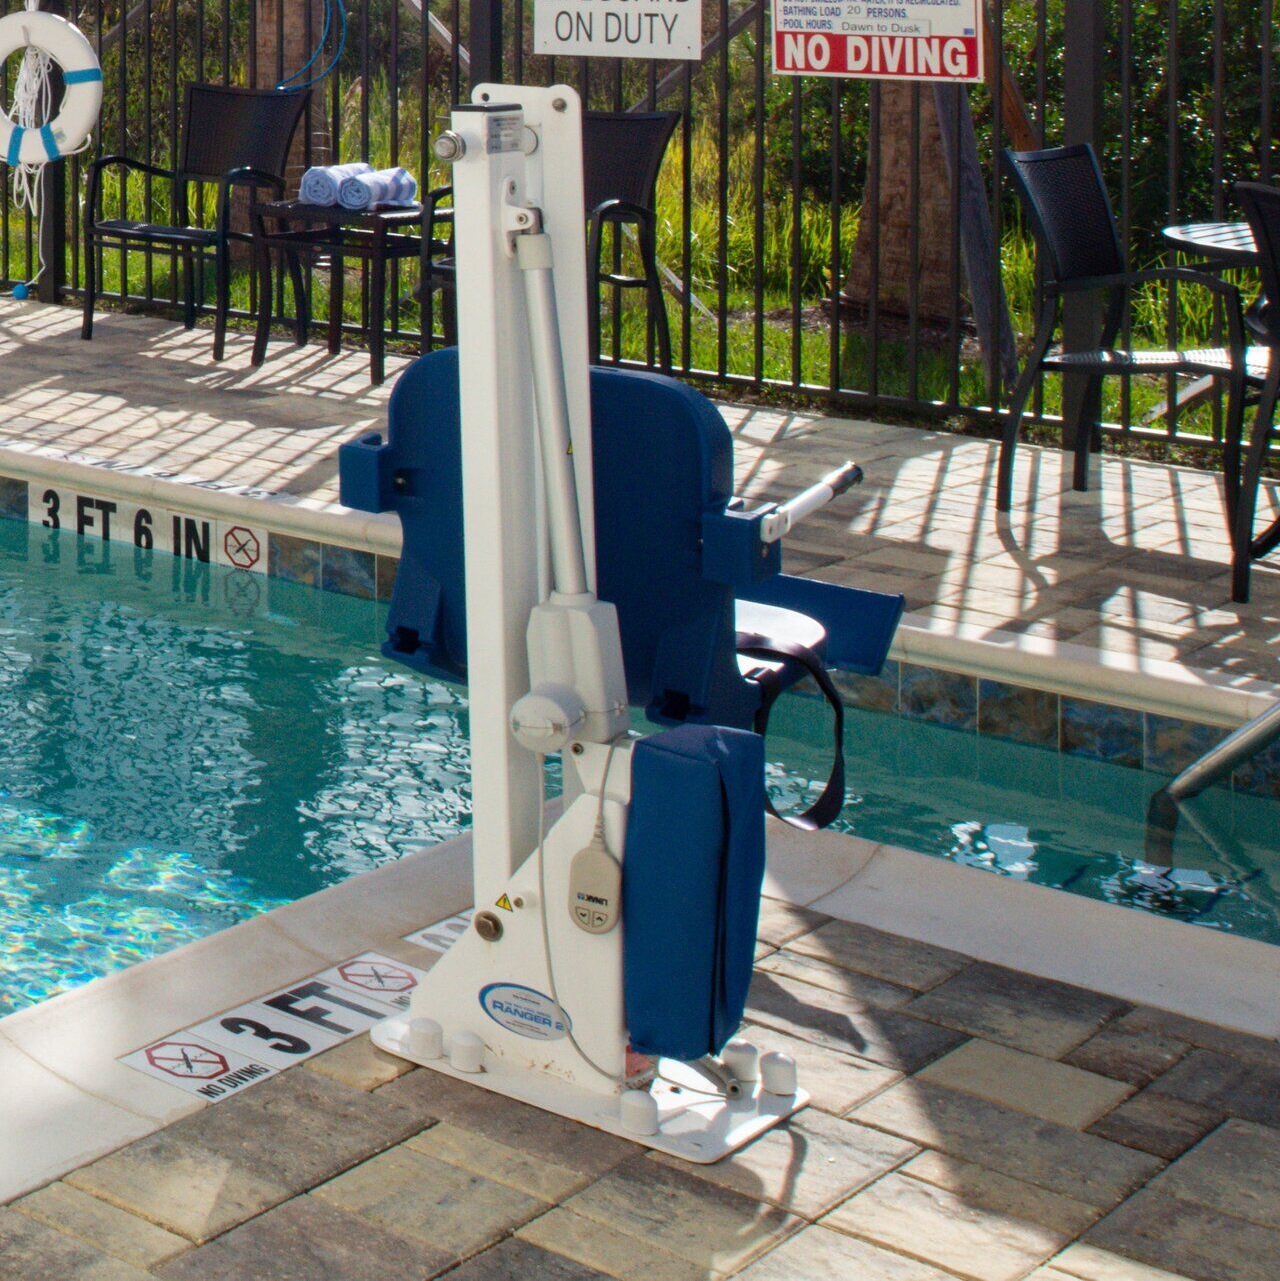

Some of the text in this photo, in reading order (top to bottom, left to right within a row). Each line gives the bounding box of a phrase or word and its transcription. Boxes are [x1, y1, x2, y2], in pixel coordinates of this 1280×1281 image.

[555, 11, 678, 44] ON DUTY
[783, 6, 817, 16] BATHING
[820, 7, 841, 17] LOAD
[847, 5, 861, 15] 20
[783, 18, 803, 29] POOL
[841, 21, 873, 31] Dawn
[877, 23, 887, 31] to
[891, 23, 920, 33] Dusk
[784, 33, 968, 76] NO DIVING
[42, 489, 210, 563] 3 FT 6 IN
[218, 981, 388, 1054] 3 FT
[492, 999, 553, 1028] RANGER
[197, 1063, 271, 1099] NO DIVING
